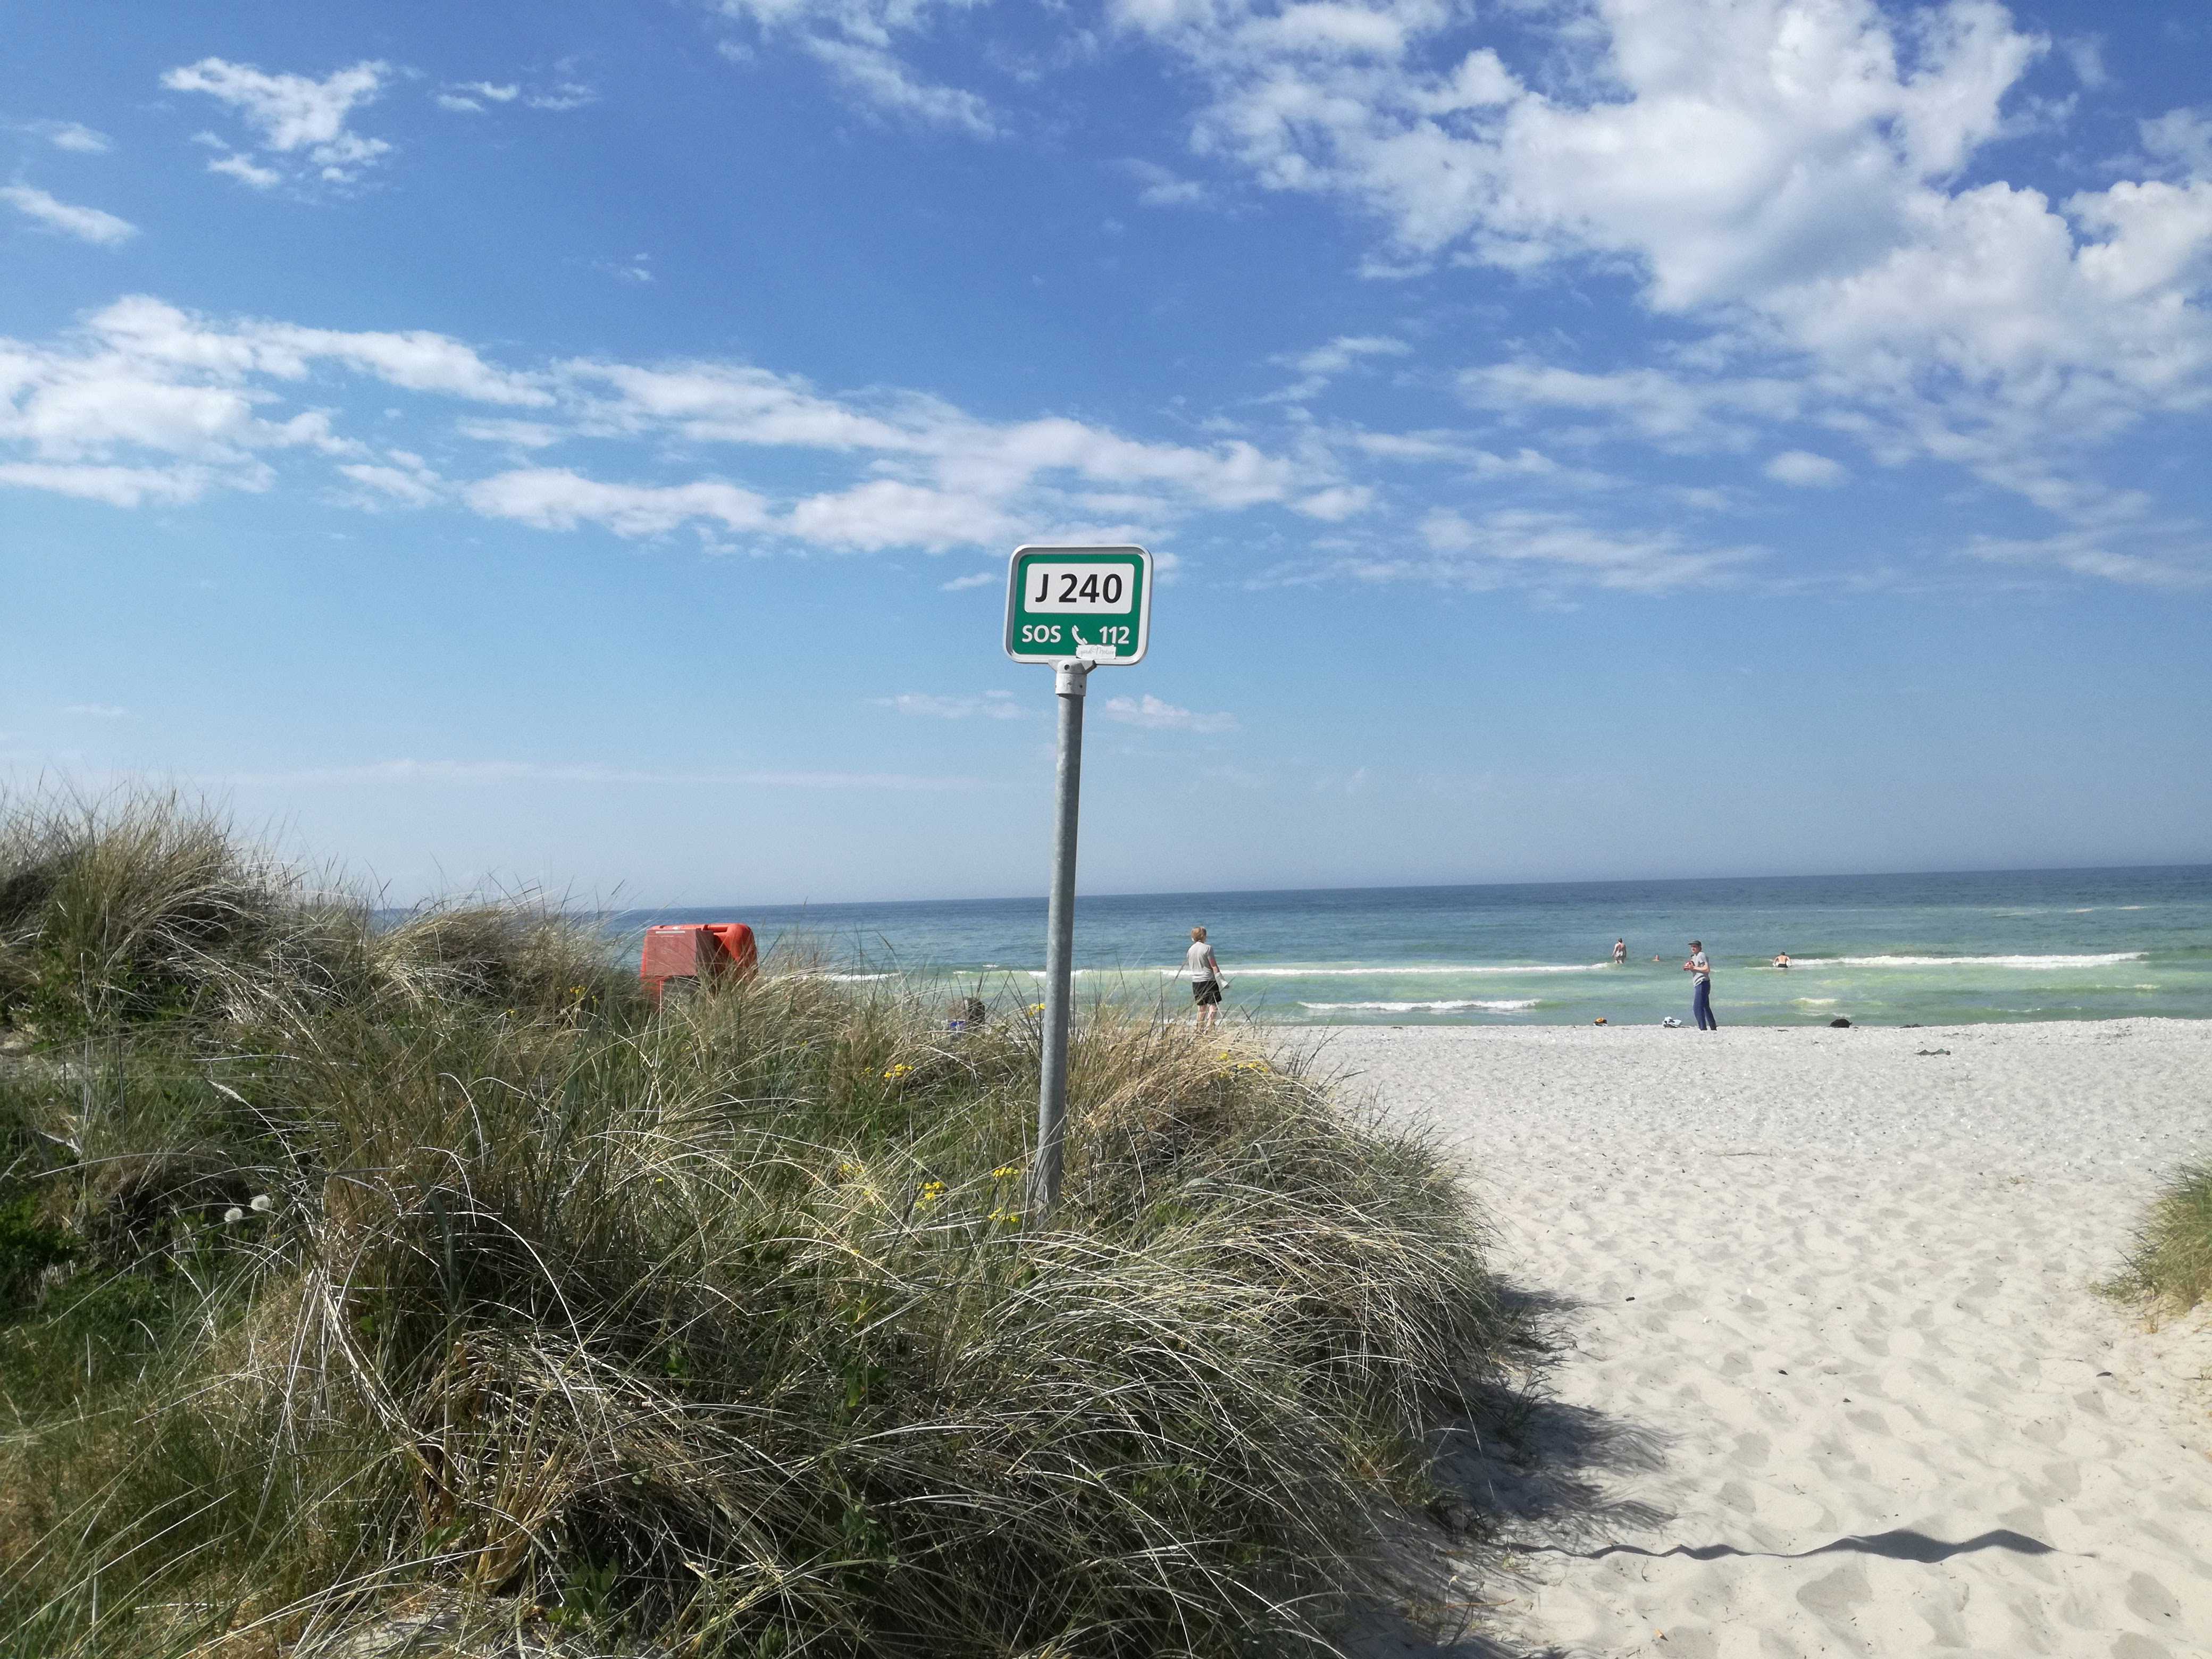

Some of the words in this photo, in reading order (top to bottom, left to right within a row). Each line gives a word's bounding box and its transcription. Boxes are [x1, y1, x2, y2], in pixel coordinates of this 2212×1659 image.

[1035, 574, 1049, 602] J
[1059, 574, 1122, 604] 240
[1022, 625, 1061, 643] SOS
[1099, 626, 1129, 644] 112
